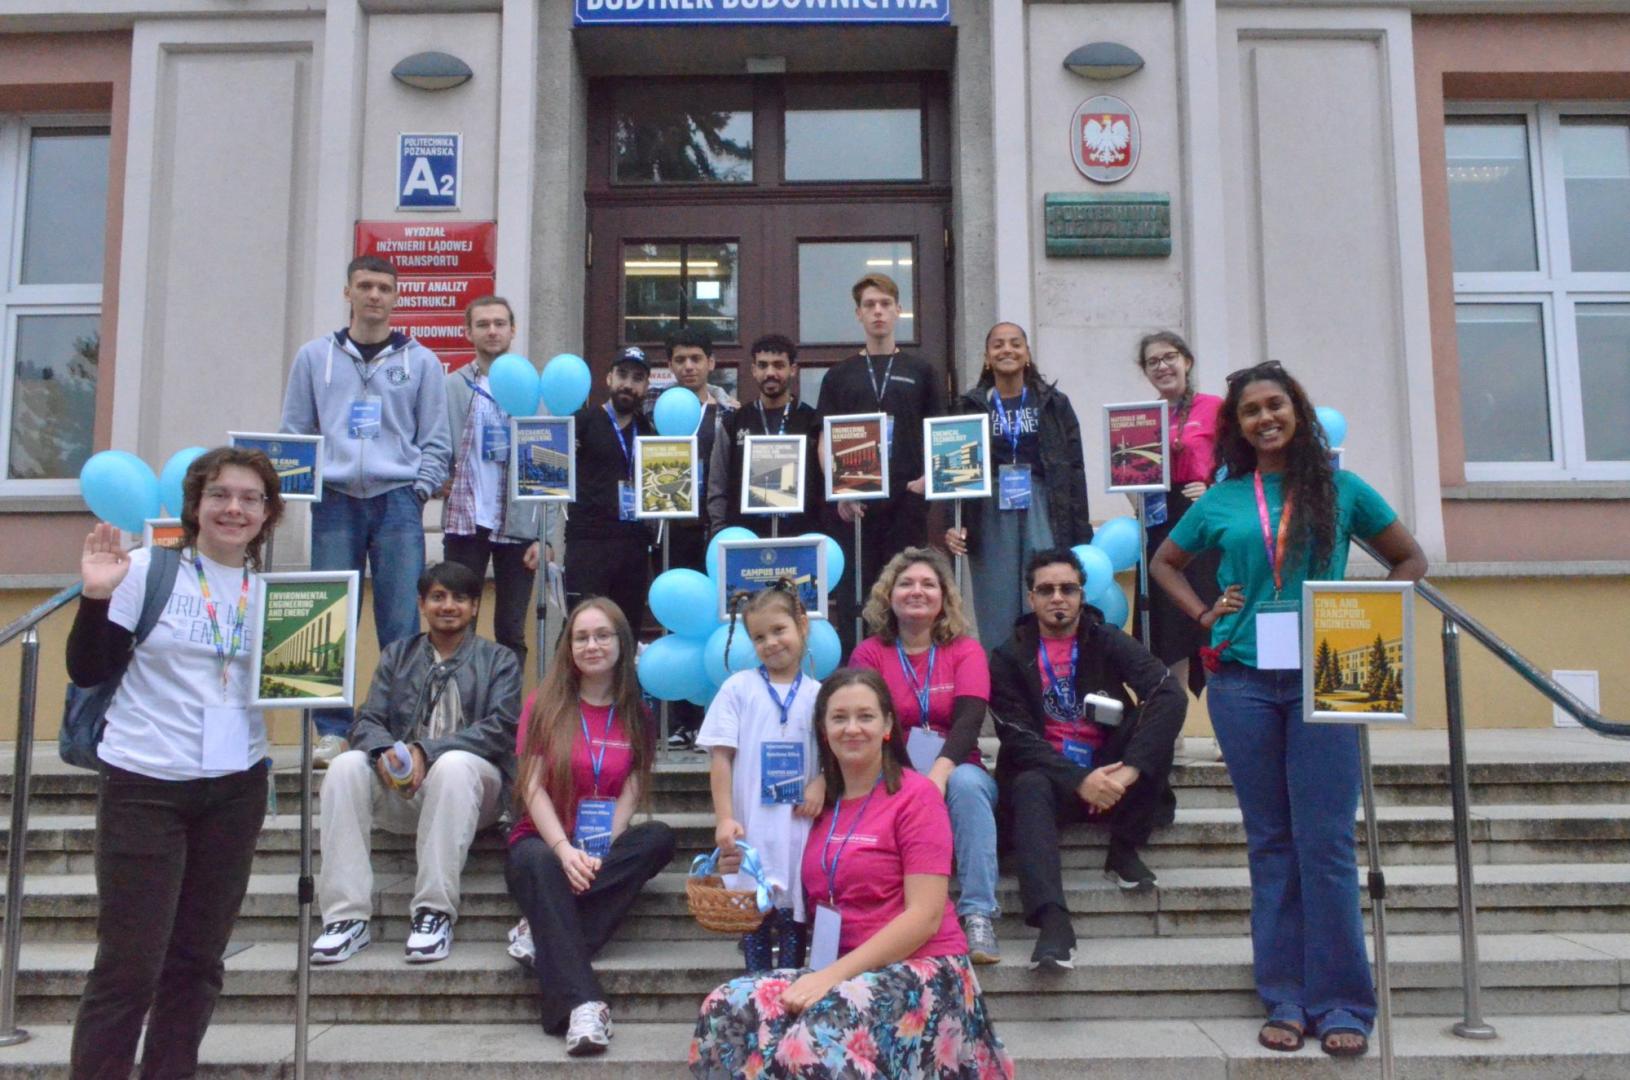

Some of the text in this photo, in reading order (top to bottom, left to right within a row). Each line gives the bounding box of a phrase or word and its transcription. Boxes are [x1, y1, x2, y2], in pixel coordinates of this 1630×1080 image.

[404, 138, 454, 146] POLITECHNIKA
[404, 227, 445, 237] WYDZIAŁ
[376, 239, 472, 252] INŻYNIERII LĄDOWEJ
[397, 255, 458, 266] TRANSPORTU
[396, 281, 468, 292] TYTUT ANALIZY
[398, 296, 456, 307] ONSTRUKCJI
[410, 326, 464, 337] BUDOWNIC
[741, 568, 774, 577] CAMPUS
[269, 591, 328, 600] ENVIRONMENTAL
[268, 600, 314, 609] ENGINEERING
[268, 608, 310, 617] AND ENERGY
